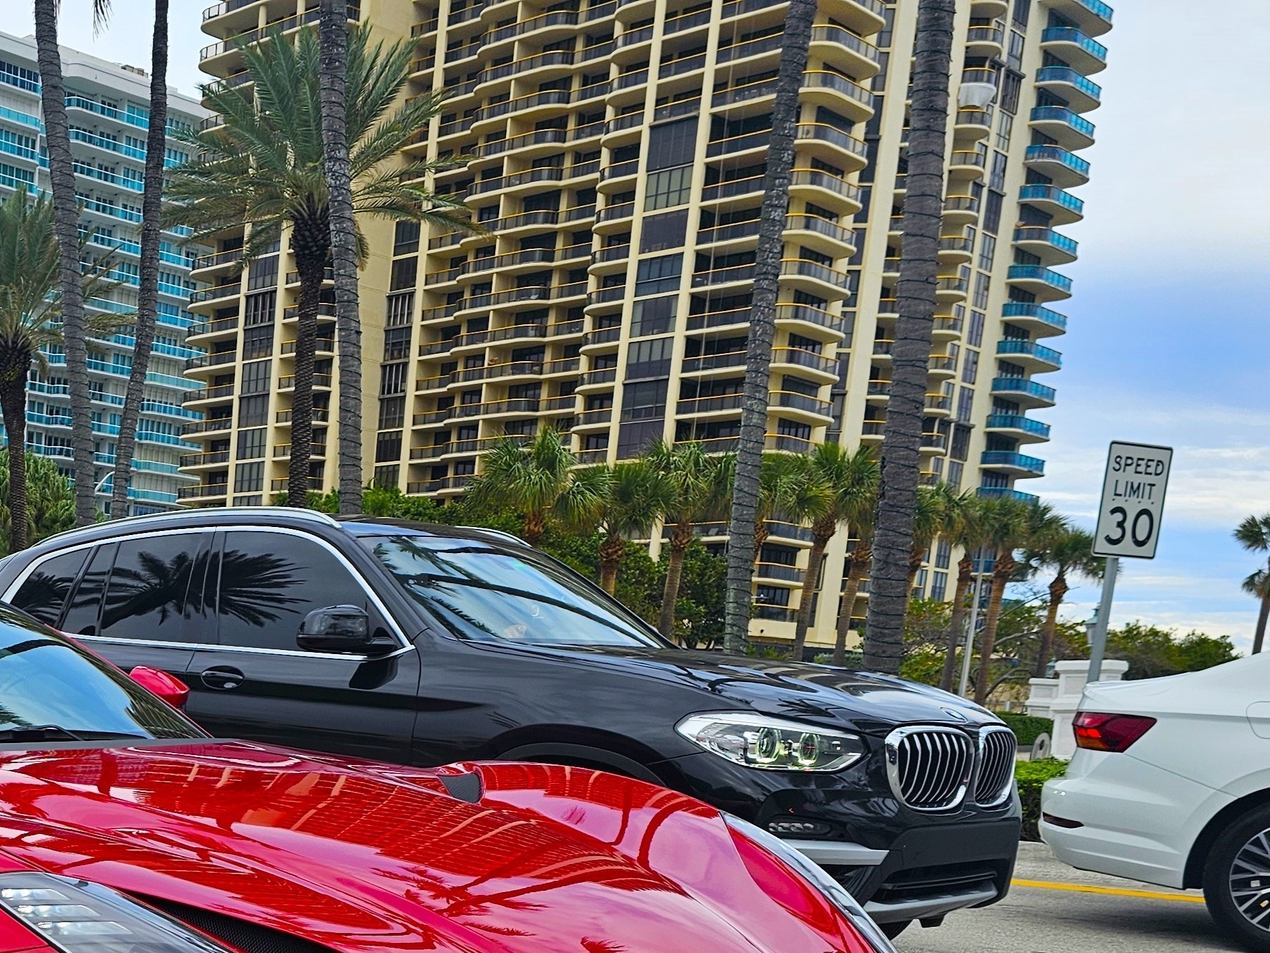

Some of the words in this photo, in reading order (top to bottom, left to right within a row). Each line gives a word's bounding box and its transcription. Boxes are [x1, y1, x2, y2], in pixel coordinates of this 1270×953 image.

[1112, 455, 1165, 476] SPEED
[1113, 480, 1156, 499] LIMIT
[1104, 506, 1154, 548] 30
